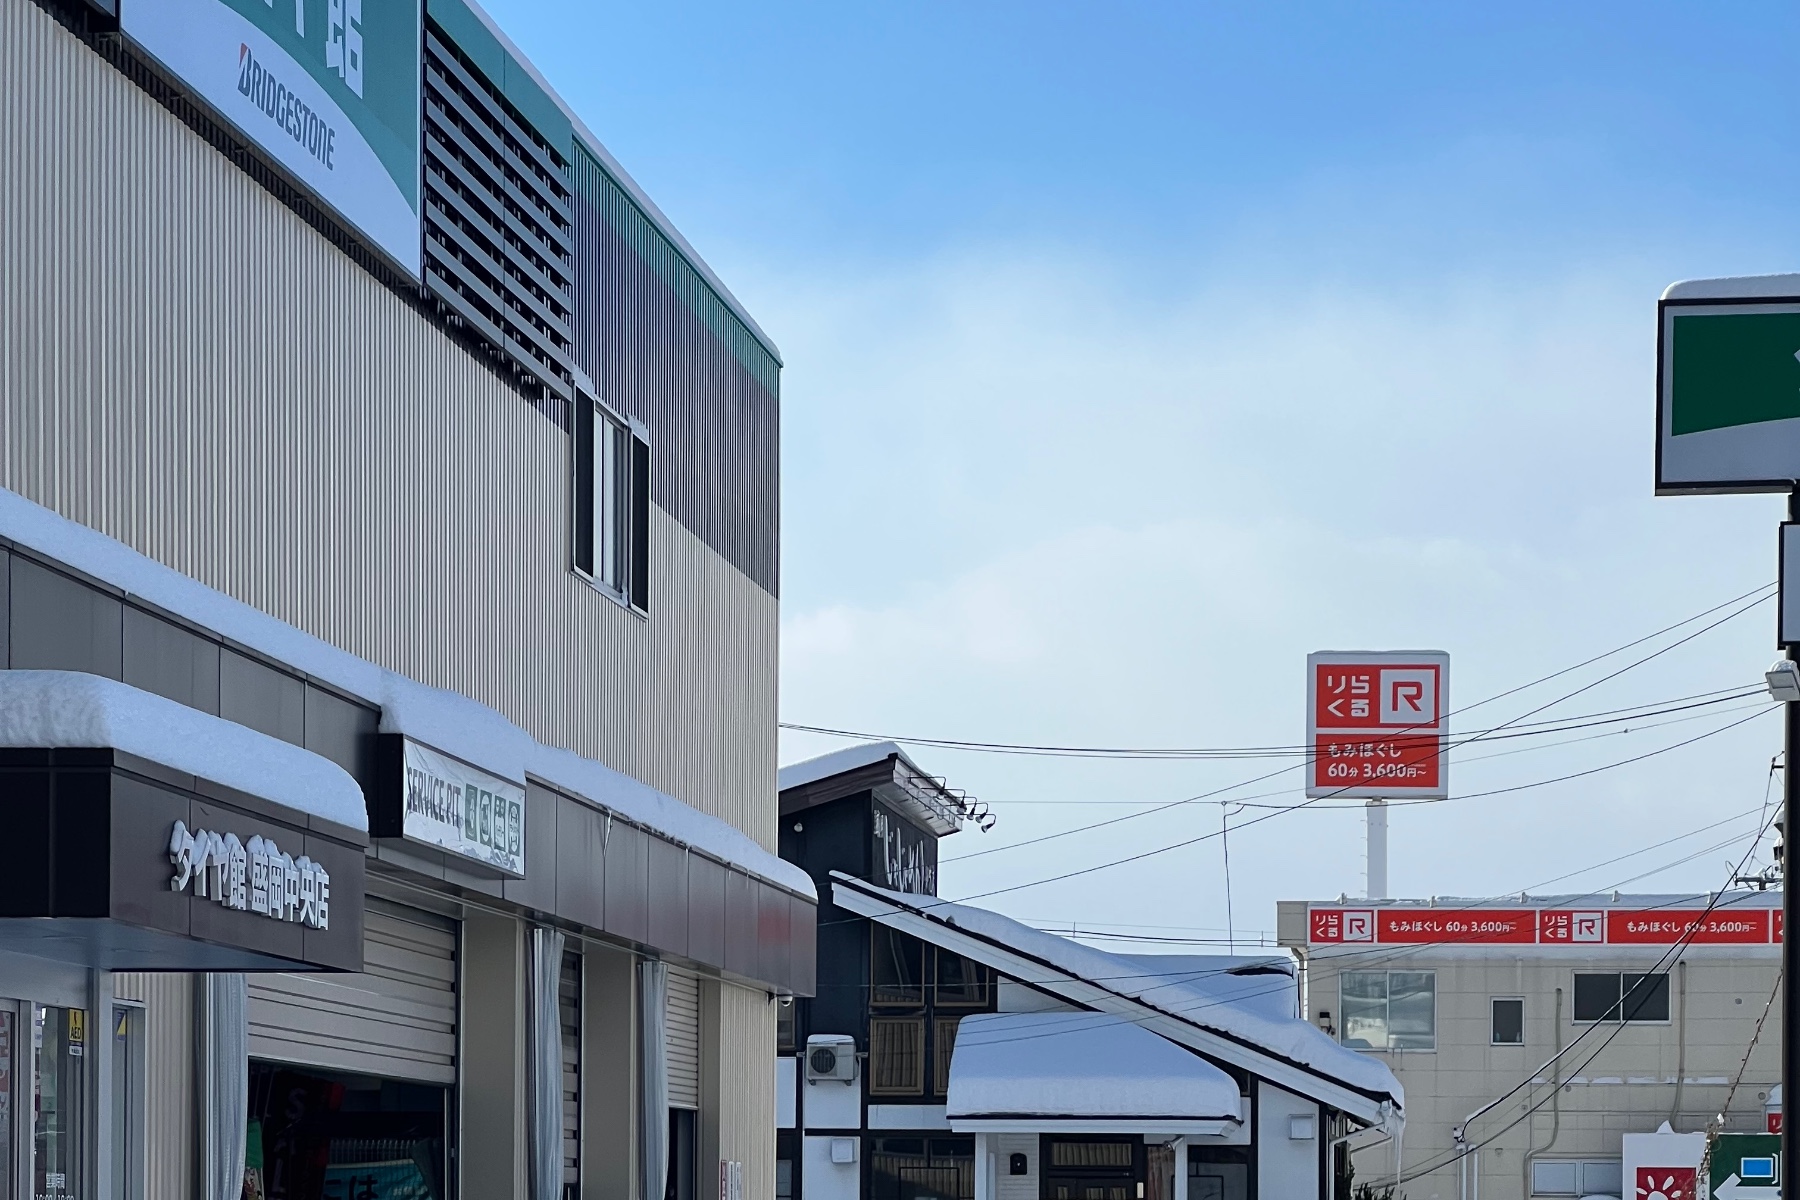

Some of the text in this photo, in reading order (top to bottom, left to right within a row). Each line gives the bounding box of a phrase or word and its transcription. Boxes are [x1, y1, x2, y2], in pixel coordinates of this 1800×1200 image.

[238, 43, 336, 171] BRIDGESTONE
[1392, 681, 1423, 712] R
[1328, 742, 1402, 758] もみほぐし
[407, 766, 462, 828] SERVICE PIT
[1349, 918, 1366, 935] R
[1389, 921, 1442, 932] もみほぐし
[1579, 918, 1595, 936] R
[1627, 921, 1681, 932] もみほぐし
[70, 1026, 82, 1039] AED
